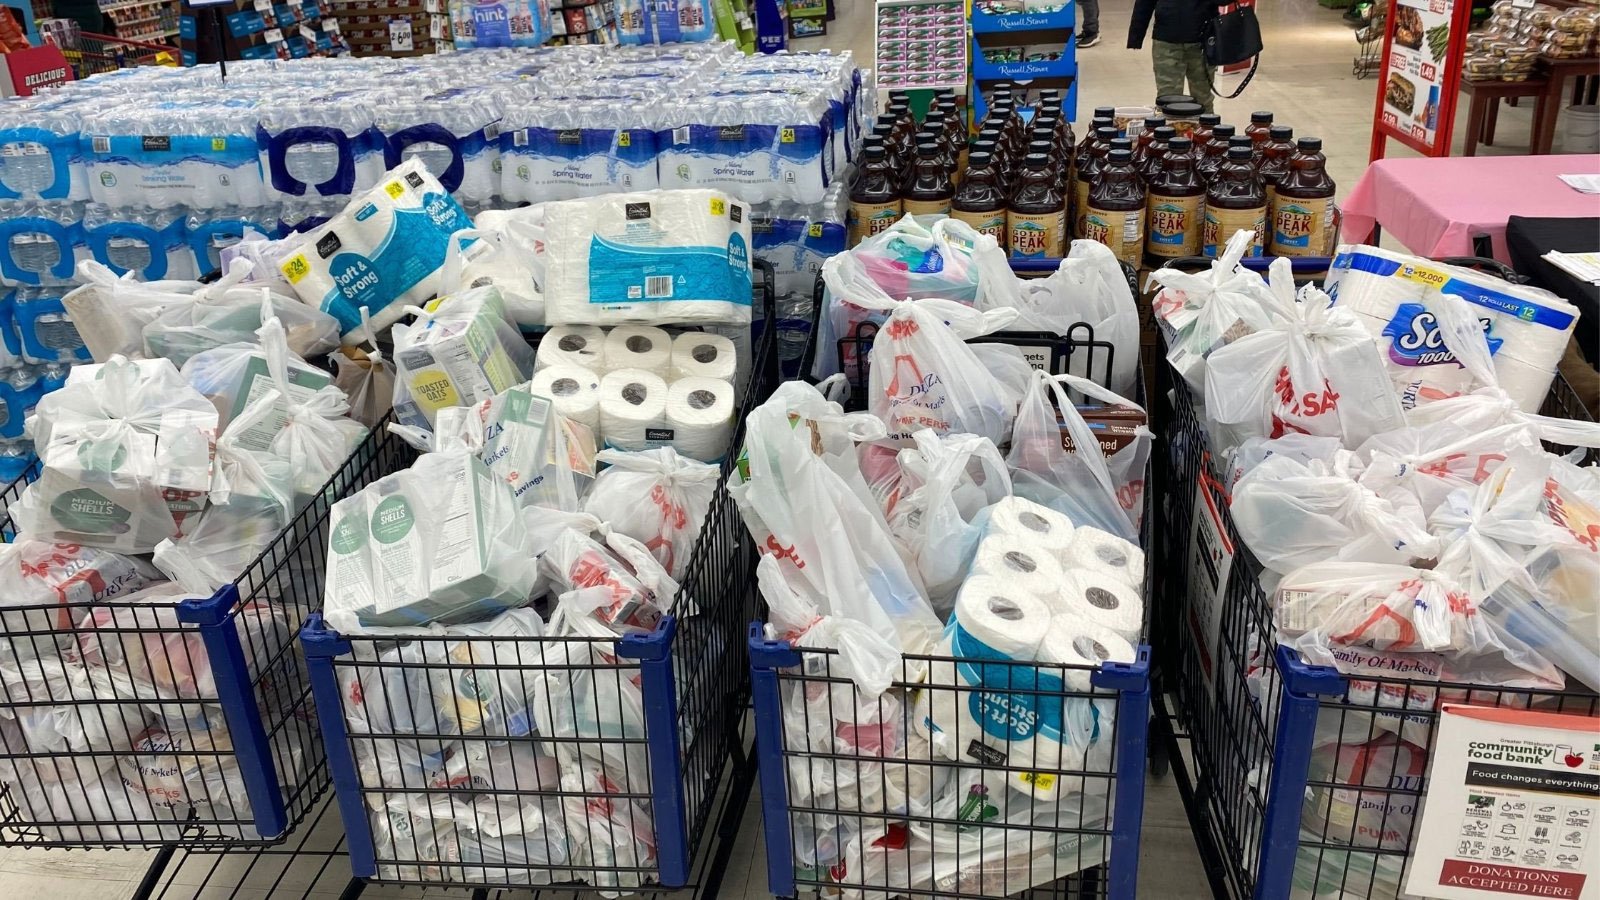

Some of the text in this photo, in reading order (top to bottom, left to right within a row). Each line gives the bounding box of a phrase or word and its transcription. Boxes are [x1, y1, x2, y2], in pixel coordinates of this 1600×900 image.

[475, 8, 505, 22] hint
[998, 17, 1048, 28] Russell Stover
[25, 68, 66, 86] DELICIOUS
[998, 65, 1048, 76] Russell Stover
[552, 170, 592, 179] Spring Water
[713, 168, 755, 176] Spring Water
[1152, 211, 1185, 219] GOLD
[1277, 212, 1311, 220] GOLD
[1087, 224, 1108, 233] OLD
[1152, 217, 1184, 230] PEAK
[1276, 218, 1310, 232] PEAK
[1013, 236, 1046, 248] PEAK
[1087, 230, 1108, 244] EAK
[729, 243, 741, 255] Soft
[729, 255, 747, 272] Strong
[334, 260, 367, 286] Soft &
[1502, 302, 1519, 311] LAST
[1522, 306, 1535, 317] 12
[1417, 351, 1456, 364] 1000
[416, 379, 450, 395] TOASTED
[427, 389, 447, 401] OATS
[72, 498, 114, 506] MEDIUM
[71, 503, 114, 515] SHELLS
[381, 504, 405, 516] MEDIUM
[381, 509, 405, 526] SHELLS
[1368, 656, 1387, 668] Of
[992, 708, 1030, 736] Soft
[1469, 741, 1554, 758] community
[1523, 740, 1554, 748] Pittsburgh
[1468, 749, 1544, 765] food bank
[1472, 770, 1498, 779] Food
[1501, 772, 1542, 784] changes
[1361, 798, 1396, 815] amiy
[1358, 825, 1401, 841] PUMP
[1468, 864, 1560, 883] DONATIONS
[1448, 875, 1573, 897] ACCEPTED HERE
